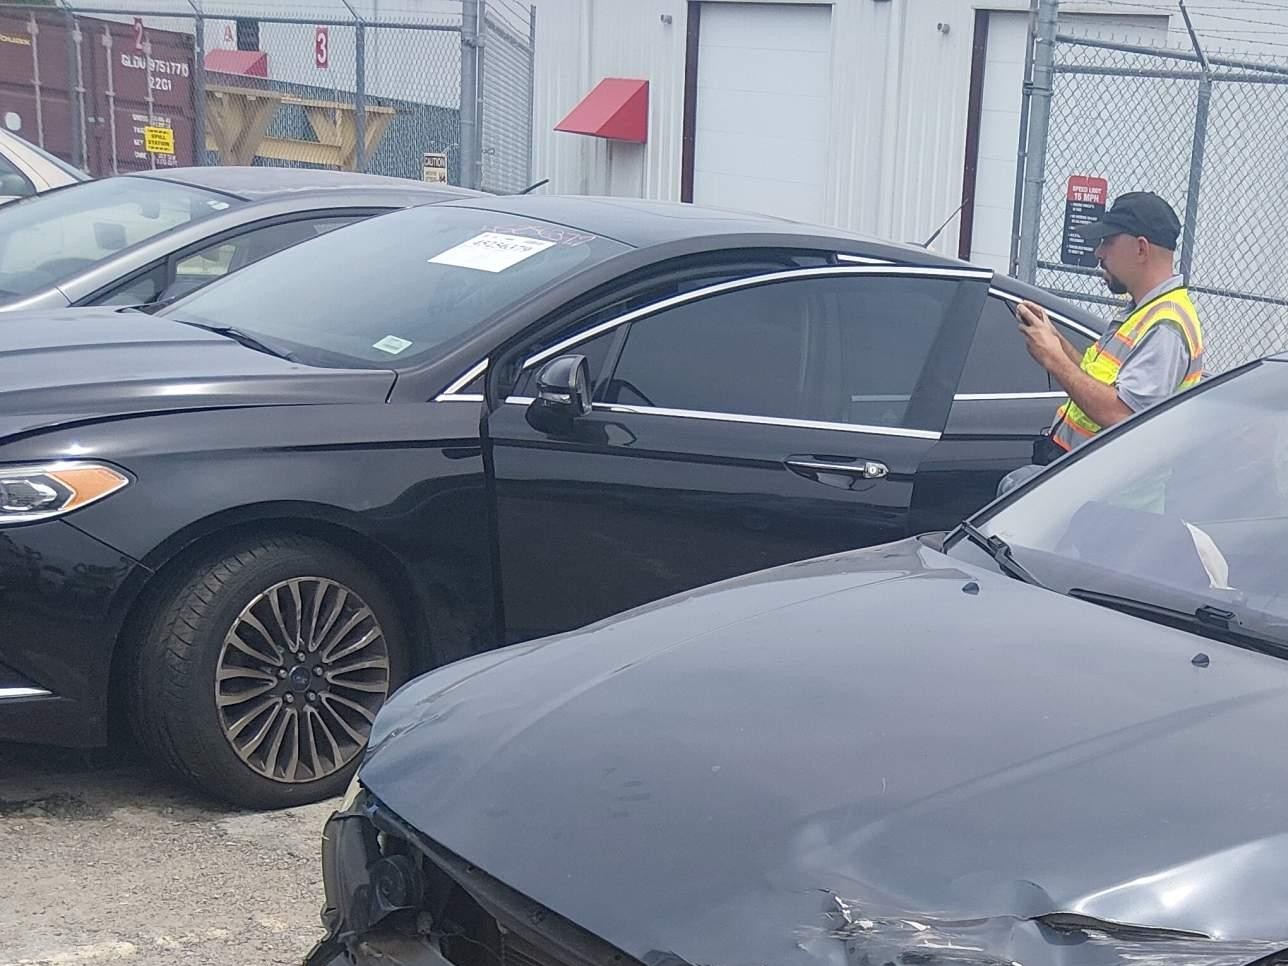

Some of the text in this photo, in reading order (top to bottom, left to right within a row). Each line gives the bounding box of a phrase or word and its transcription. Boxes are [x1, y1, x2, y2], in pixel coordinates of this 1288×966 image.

[135, 22, 144, 50] 2
[317, 32, 327, 63] 3
[424, 157, 446, 168] CAUTION
[1074, 192, 1099, 203] 15 MPH
